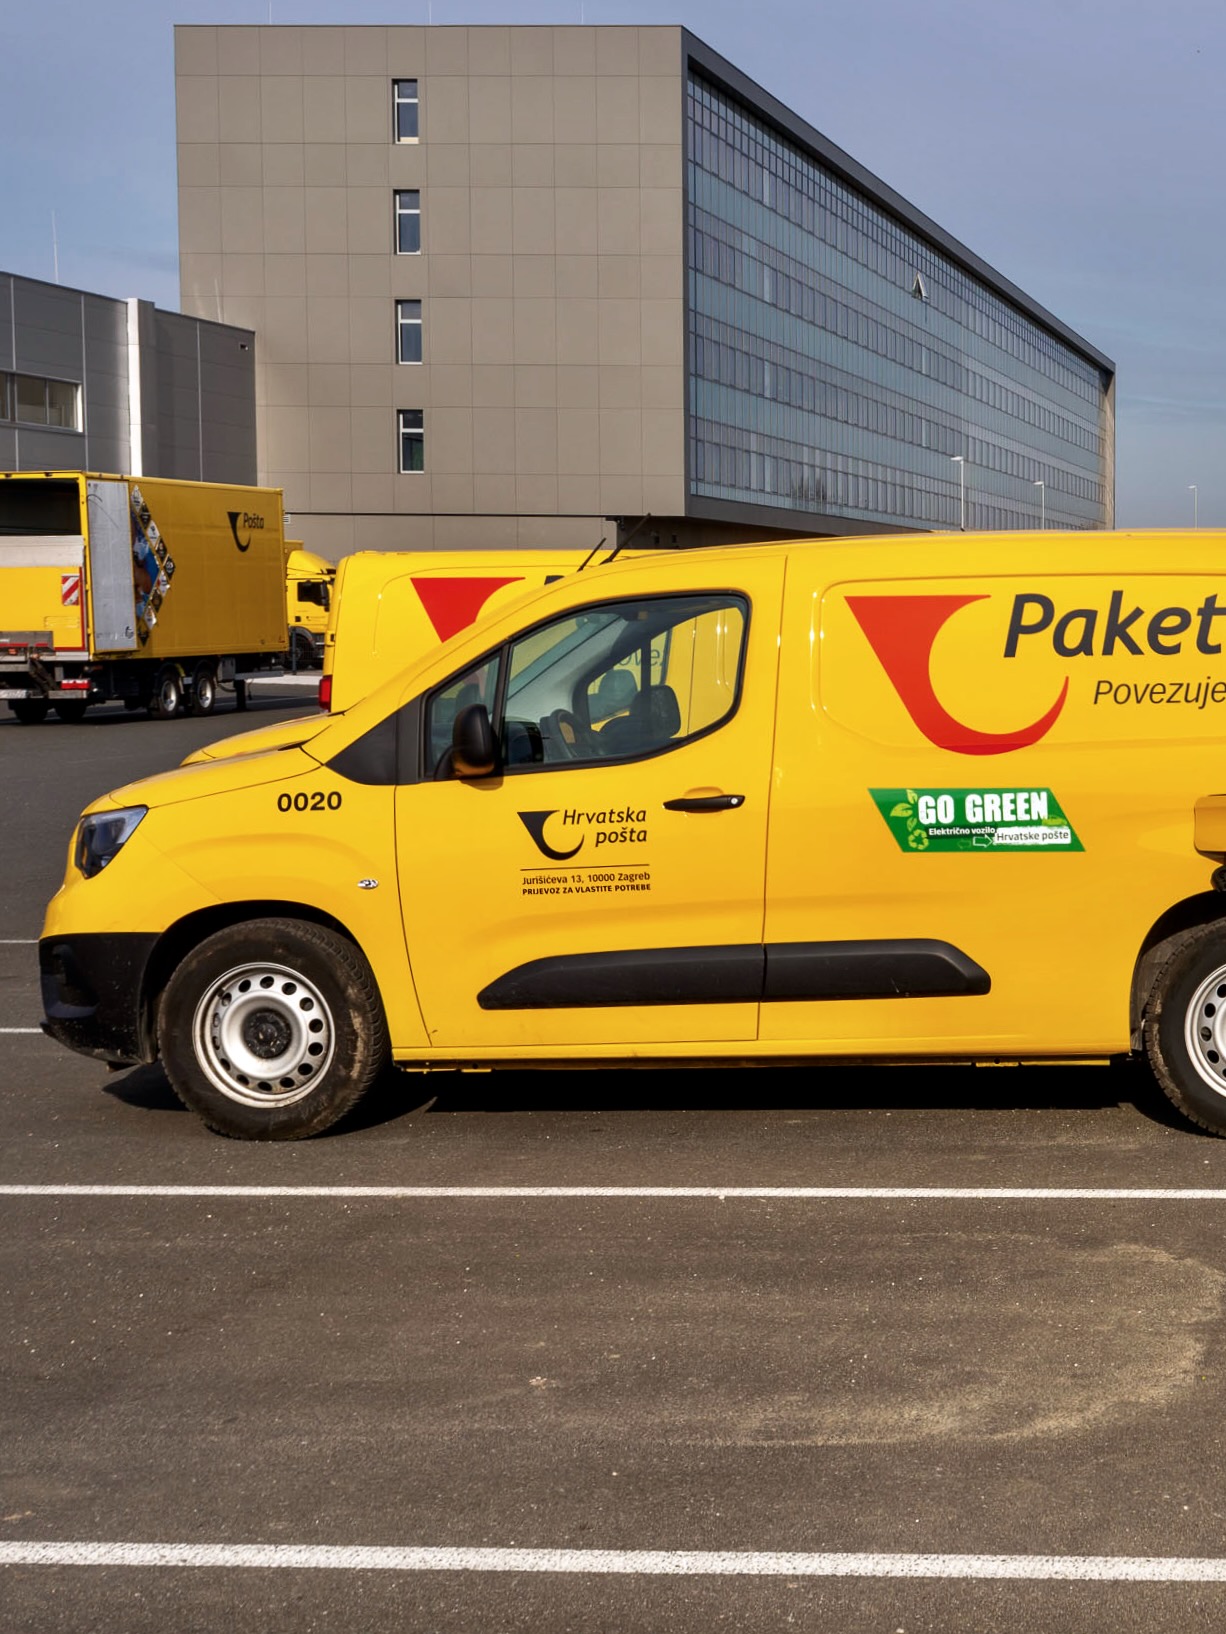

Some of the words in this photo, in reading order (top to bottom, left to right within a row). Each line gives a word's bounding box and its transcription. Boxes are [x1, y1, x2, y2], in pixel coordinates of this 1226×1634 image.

[243, 512, 265, 529] Pošta
[277, 791, 342, 812] 0020
[918, 795, 955, 825] GO
[965, 791, 1048, 823] GREEN
[563, 806, 647, 825] Hrvatska
[595, 826, 648, 848] pošta
[928, 826, 970, 836] Električno
[971, 826, 996, 835] vozilo
[997, 830, 1040, 842] Hrvatske
[1042, 829, 1069, 842] pošte
[522, 874, 568, 885] Jurišićeva
[571, 874, 585, 884] 13,
[588, 873, 616, 883] 10000
[618, 871, 651, 883] Zagreb
[522, 886, 560, 895] PRIJEVOZ
[563, 886, 574, 894] ZA
[576, 884, 612, 893] VLASTITE
[615, 883, 651, 892] POTREBE
